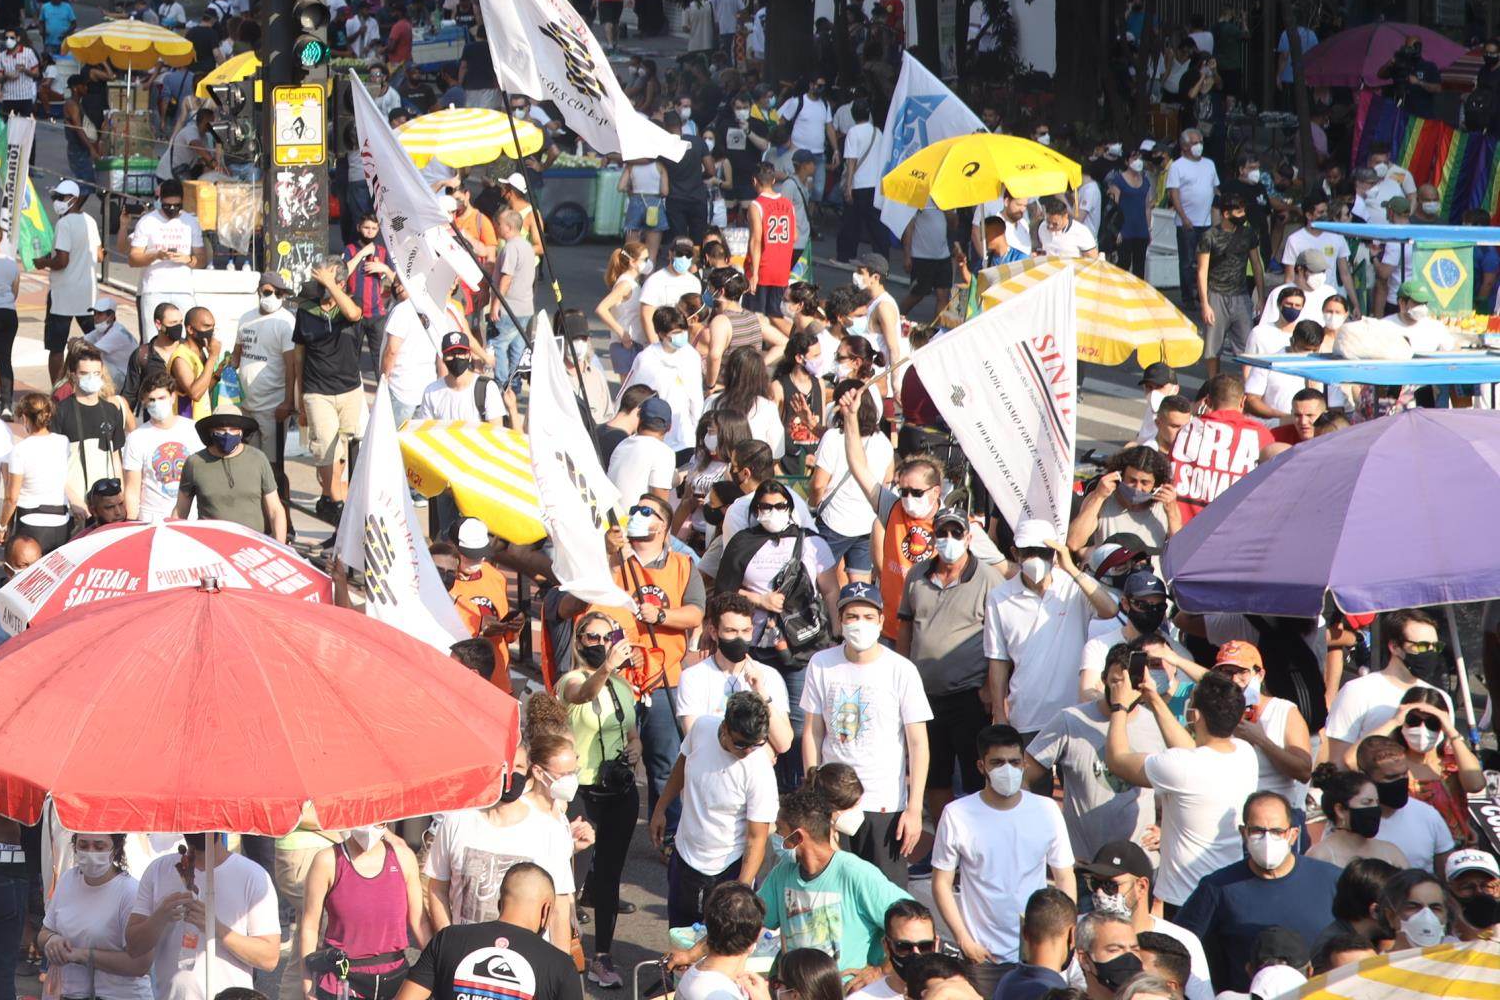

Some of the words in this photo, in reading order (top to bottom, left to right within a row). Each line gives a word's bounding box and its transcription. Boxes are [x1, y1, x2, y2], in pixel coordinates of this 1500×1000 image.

[279, 91, 318, 101] CICLISTA
[767, 215, 790, 244] 23
[1172, 416, 1260, 476] ORA
[85, 567, 128, 589] VERÃO
[129, 577, 141, 589] DE
[156, 570, 186, 586] PURO
[189, 562, 228, 584] MALTE
[63, 587, 92, 611] SÃO
